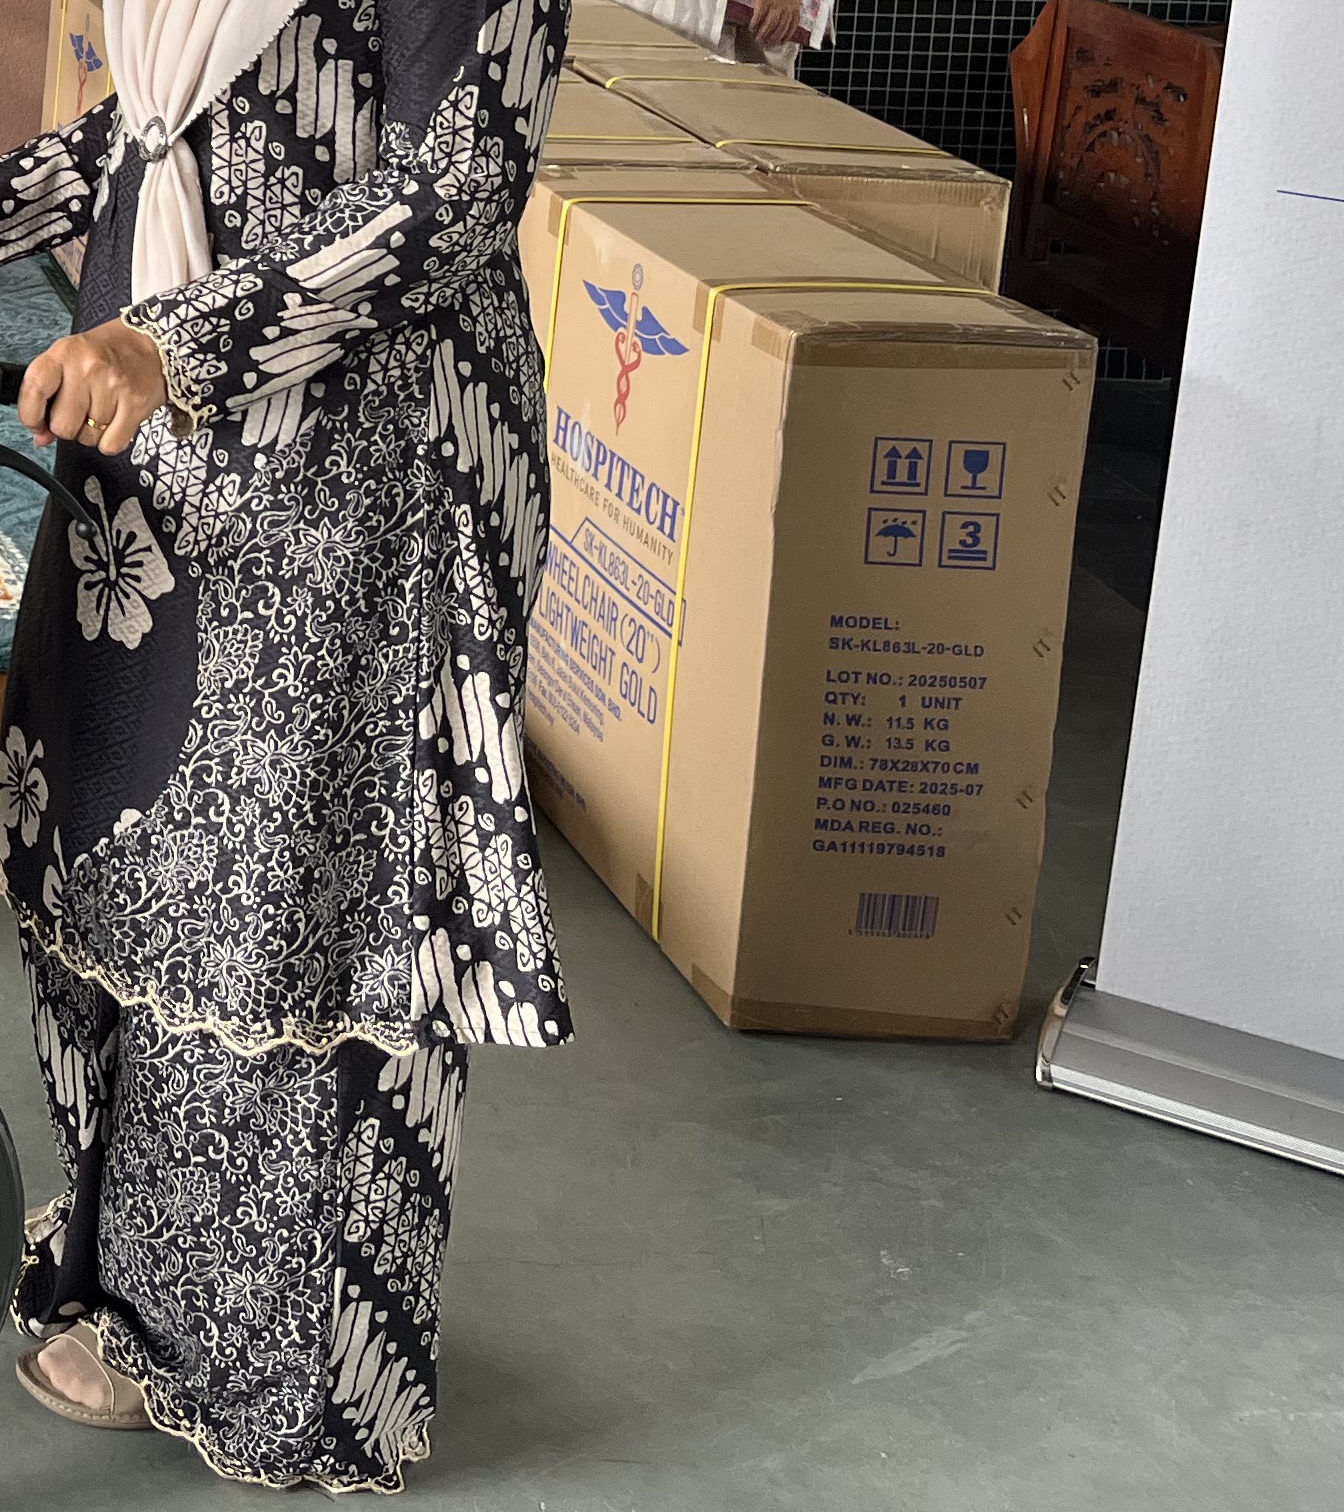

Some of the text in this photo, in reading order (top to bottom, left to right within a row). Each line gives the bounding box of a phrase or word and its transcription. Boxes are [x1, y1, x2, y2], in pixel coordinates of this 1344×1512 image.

[553, 405, 680, 543] HOSPITECH
[551, 451, 674, 566] HEALTHCARE FOR HUMANITY
[583, 528, 675, 628] SK-KL863L-20-GLD
[545, 541, 619, 641] WHEELCHAIR
[830, 615, 900, 630] MODEL:
[538, 585, 616, 686] LIGHTWEIGHT
[619, 661, 658, 725] GOLD
[828, 636, 985, 657] SK-KL863L-20-GLD
[825, 669, 988, 689] LOT NO.: 20250507
[824, 691, 963, 710] QTY: 1 UNIT
[823, 712, 841, 726] N.
[845, 713, 872, 728] W.:
[924, 718, 949, 731] KG
[821, 734, 840, 748] G.
[845, 735, 871, 750] W.:
[925, 739, 951, 753] KG
[820, 755, 864, 769] DIM.:
[818, 776, 984, 796] MFG DATE: 2025-07
[816, 797, 845, 811] P.O
[850, 799, 887, 814] NO.:
[814, 818, 943, 837] MDA REG. NO.:
